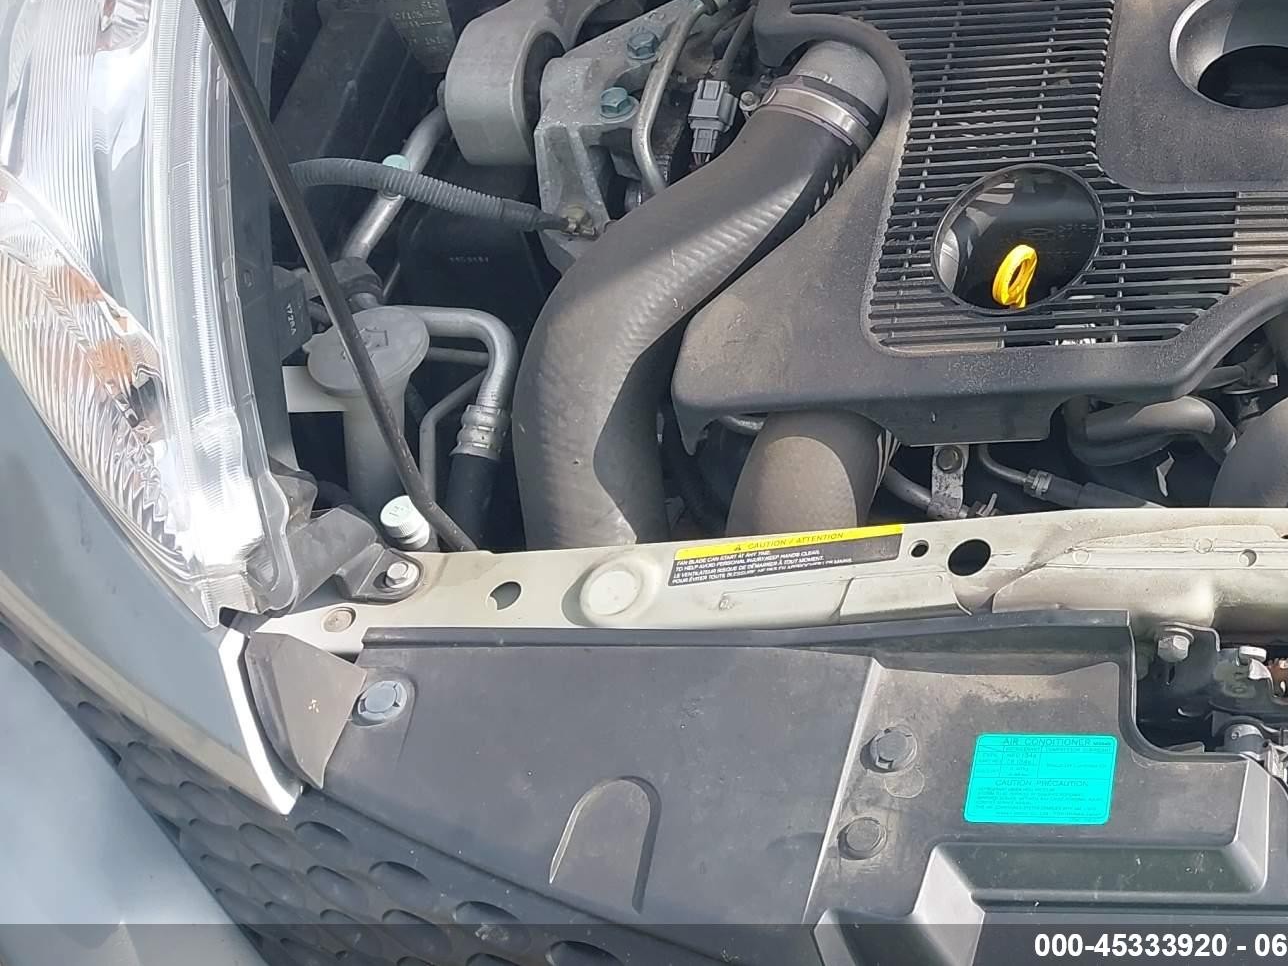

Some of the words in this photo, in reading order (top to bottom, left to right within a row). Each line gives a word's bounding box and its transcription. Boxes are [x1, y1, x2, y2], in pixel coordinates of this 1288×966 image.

[747, 540, 786, 550] CAUTION
[796, 533, 844, 544] ATTENTION
[689, 557, 706, 565] BLADE
[699, 562, 716, 570] AVOID
[1003, 738, 1018, 746] AIR
[1024, 738, 1091, 746] CONDITIONER
[995, 779, 1032, 787] CAUTION
